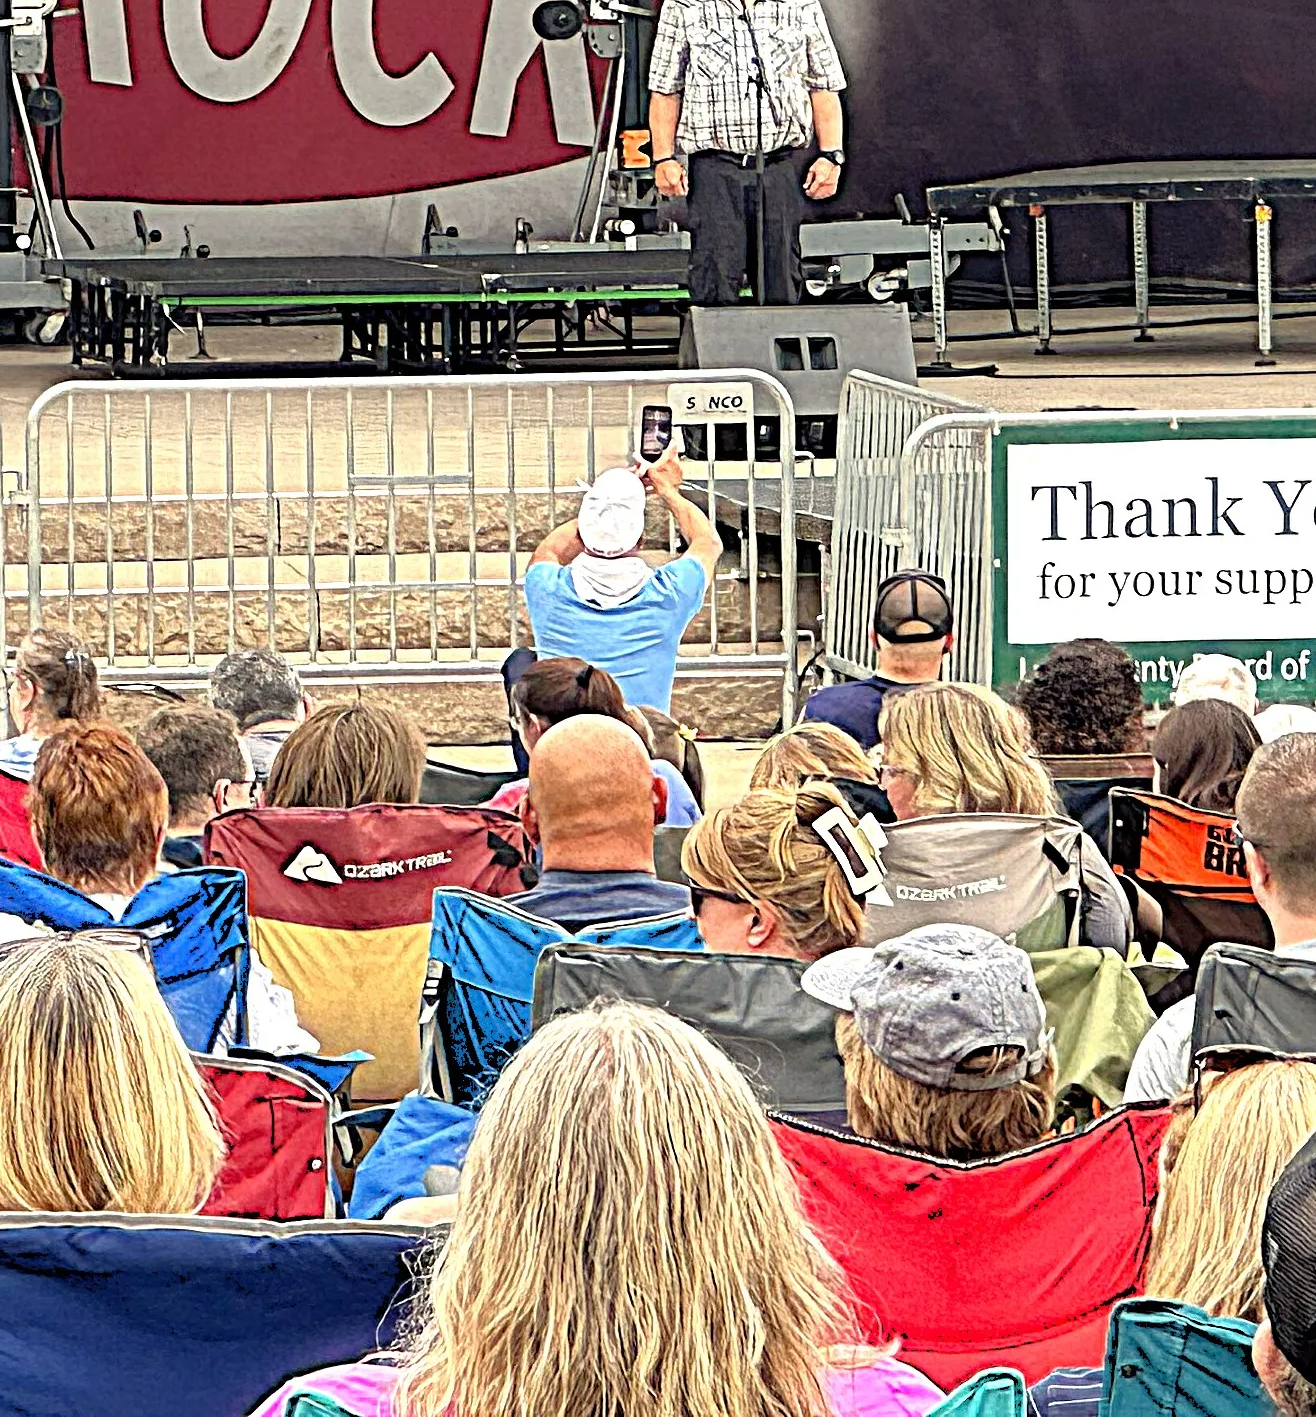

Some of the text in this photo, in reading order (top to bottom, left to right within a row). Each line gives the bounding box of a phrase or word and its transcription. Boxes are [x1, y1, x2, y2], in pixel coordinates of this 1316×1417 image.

[686, 396, 743, 409] SNCO
[1031, 476, 1246, 541] Thank
[1038, 562, 1095, 599] for
[1107, 571, 1203, 607] your
[1280, 649, 1311, 681] of
